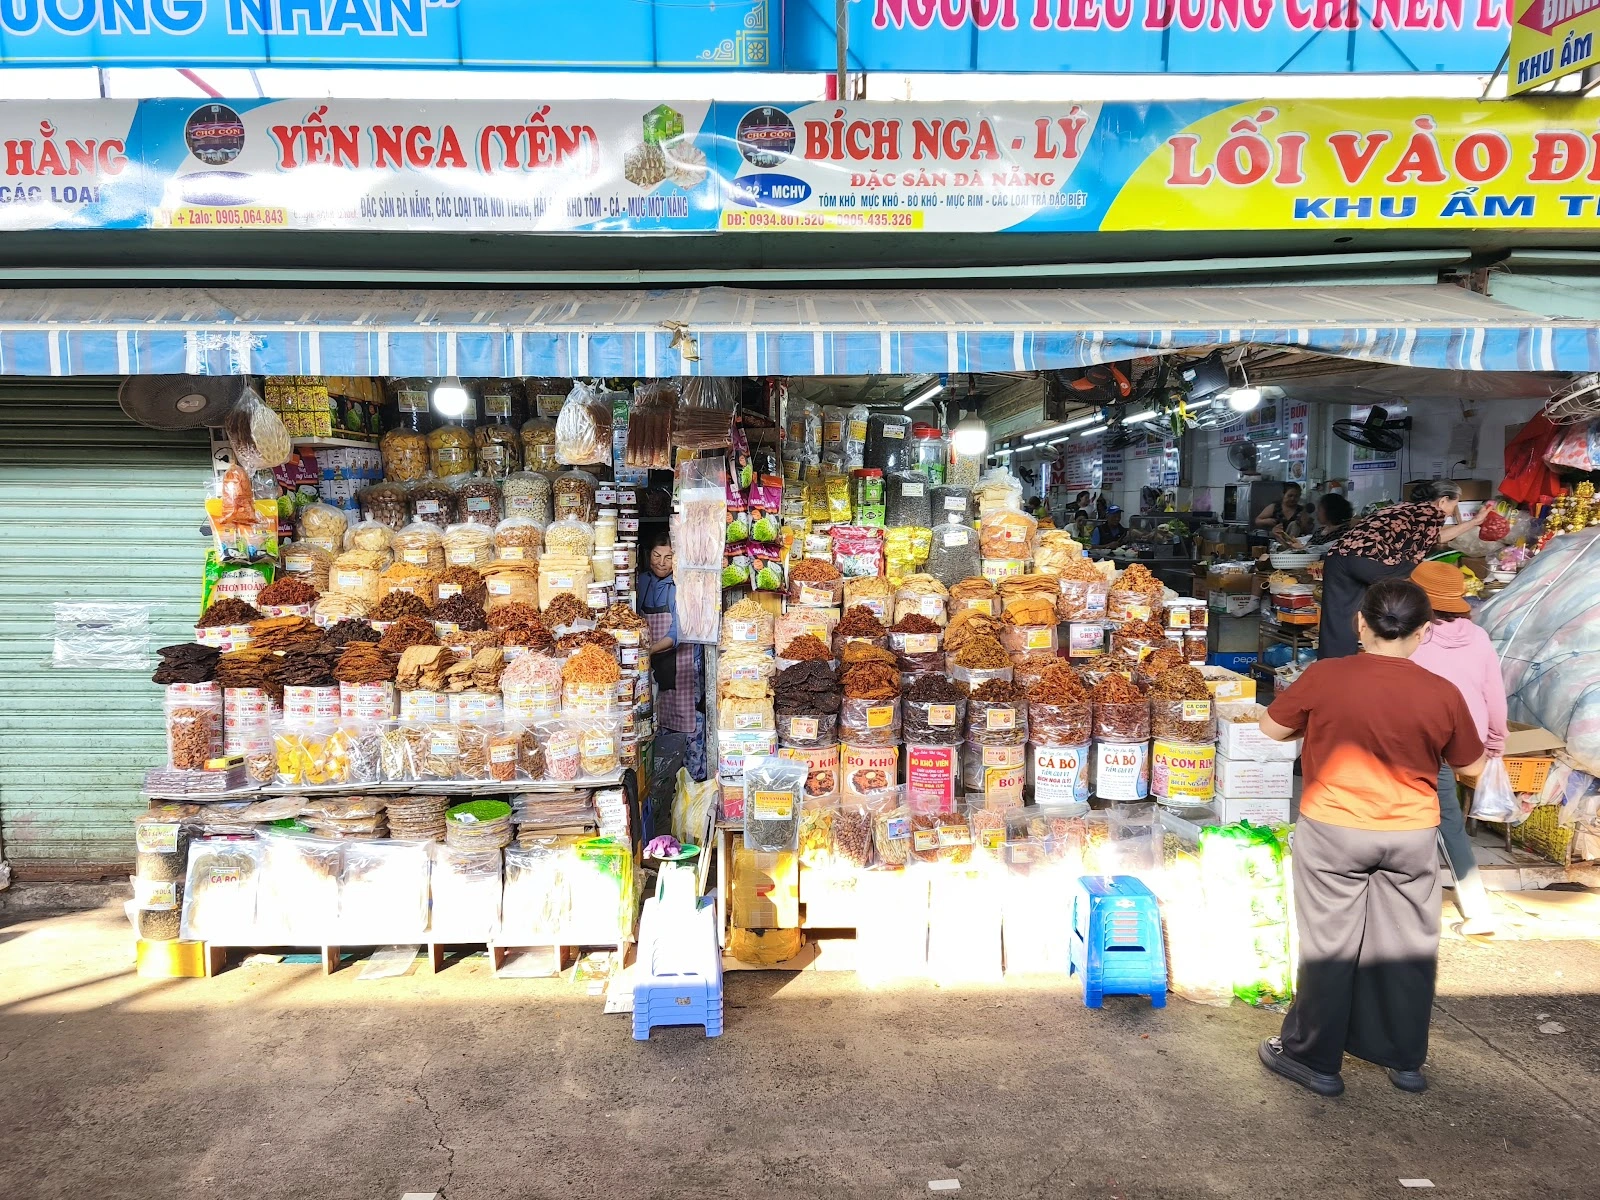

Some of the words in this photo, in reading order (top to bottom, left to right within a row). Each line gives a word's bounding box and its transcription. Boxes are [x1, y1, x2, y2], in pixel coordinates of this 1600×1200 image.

[1517, 47, 1555, 85] KHU
[1560, 30, 1593, 67] ẨM
[270, 106, 360, 170] YẾN
[371, 125, 468, 170] NGA
[480, 106, 599, 176] (YẾN)
[803, 108, 901, 161] BÍCH
[911, 118, 1001, 161] NGA
[1033, 105, 1088, 161] LÝ
[3, 120, 127, 176] HẰNG
[1167, 107, 1308, 186] LỐI
[1327, 115, 1510, 186] VÀO
[850, 168, 897, 191] ĐẶC
[902, 167, 948, 187] SẢN
[953, 167, 986, 187] ĐÀ
[991, 165, 1056, 187] NẴNG
[771, 185, 806, 199] MCHV
[819, 193, 837, 207] TÔM
[839, 194, 856, 207] KHÔ
[860, 193, 879, 209] MỰC
[882, 193, 898, 207] KHÔ
[907, 193, 919, 207] BÒ
[921, 193, 937, 207] KHÔ
[946, 192, 965, 209] MỰC
[967, 194, 983, 207] RIM
[992, 192, 1009, 207] CÁC
[1049, 193, 1067, 209] ĐẶC
[1067, 191, 1088, 209] BIỆT
[1293, 197, 1417, 219] KHU
[1439, 186, 1536, 217] ẨM
[1558, 195, 1600, 216] T
[188, 209, 213, 225] Zalo:
[215, 209, 284, 225] 0905.064.843
[360, 193, 377, 222] ĐẶC
[379, 191, 395, 218] SẢN
[396, 192, 409, 218] ĐÀ
[435, 192, 452, 218] CÁC
[453, 196, 472, 222] LOẠI
[473, 192, 489, 218] TRÀ
[583, 192, 602, 218] TÔM
[609, 191, 621, 218] CÁ
[627, 192, 647, 222] MỰC
[648, 192, 665, 222] MỘT
[666, 189, 688, 218] NẮNG
[727, 214, 746, 226] DĐ:
[749, 214, 825, 226] 0934.801.520
[836, 213, 912, 226] 0905.435.326
[1038, 755, 1055, 768] CÁ
[1059, 755, 1077, 769] BÒ
[1104, 752, 1119, 765] CÁ
[1122, 752, 1137, 766] BÒ
[1155, 753, 1167, 766] CÁ
